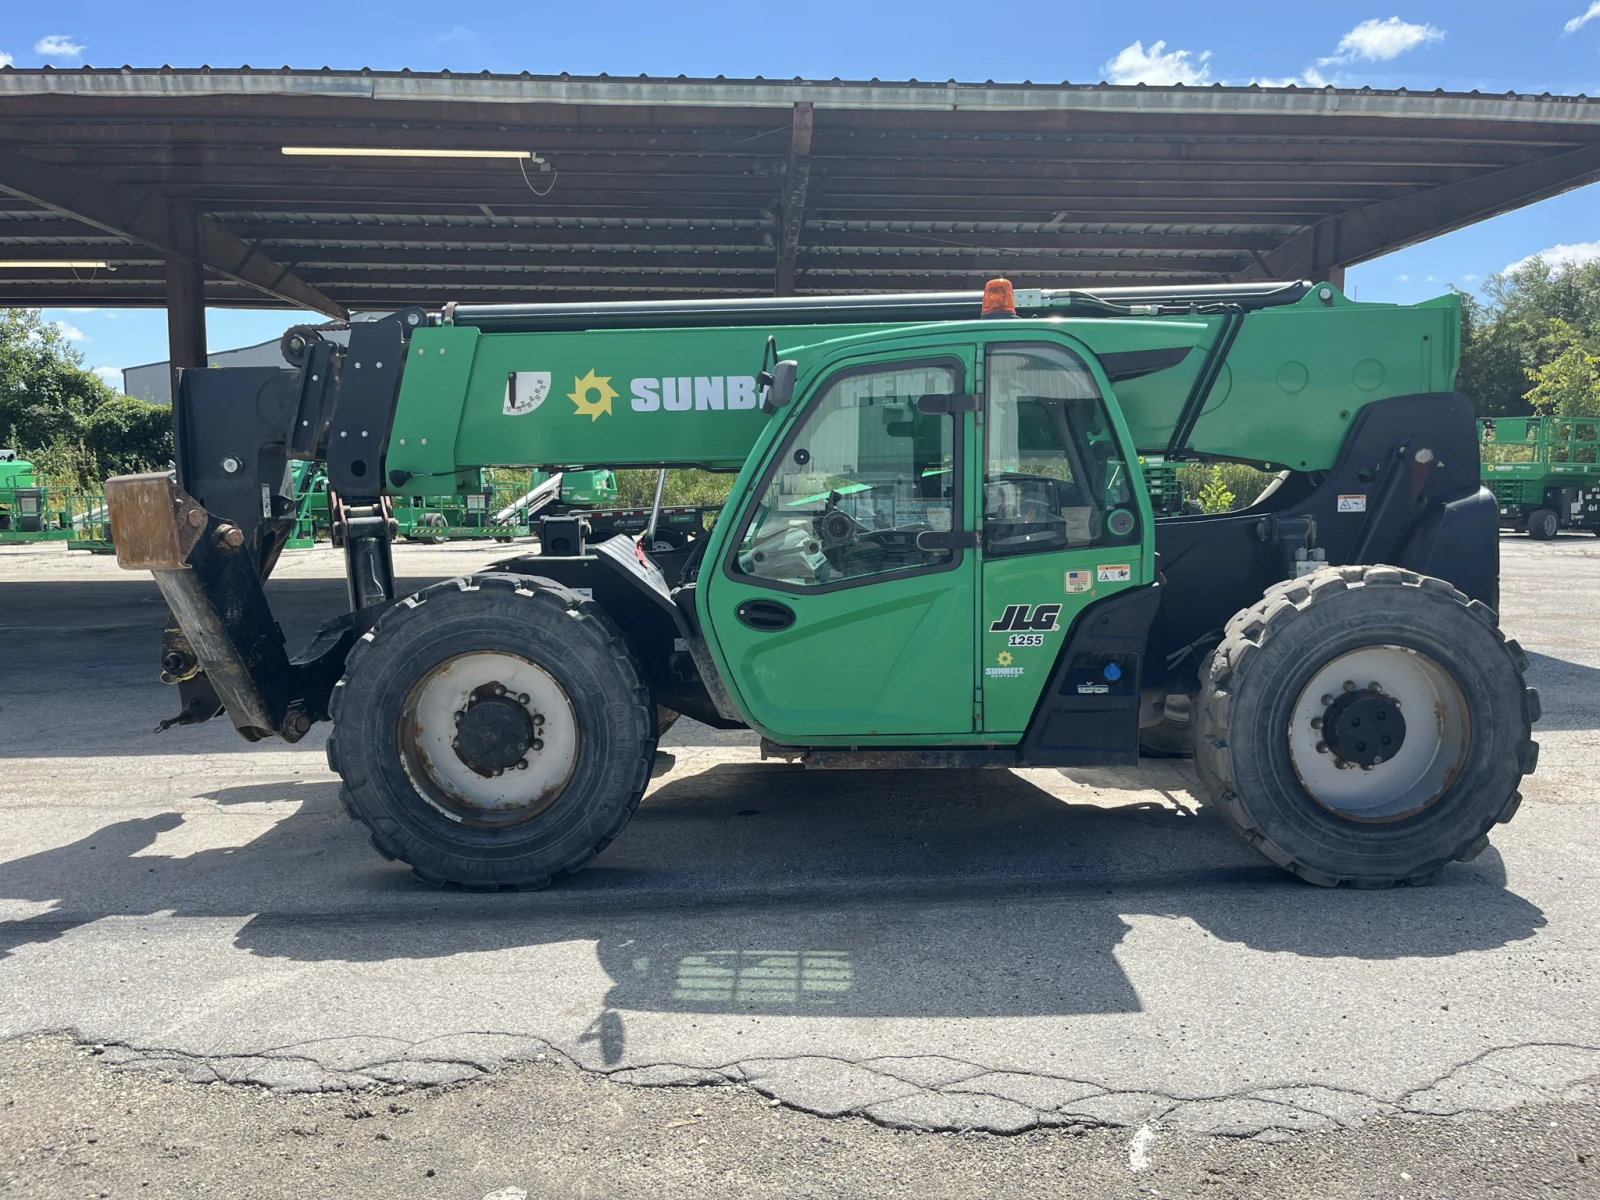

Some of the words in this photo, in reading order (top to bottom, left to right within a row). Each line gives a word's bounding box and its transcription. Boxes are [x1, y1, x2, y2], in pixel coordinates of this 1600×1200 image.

[630, 376, 772, 411] SUNB
[989, 604, 1062, 632] JLG
[1009, 635, 1043, 646] 1255
[985, 667, 1024, 675] SUNBELT
